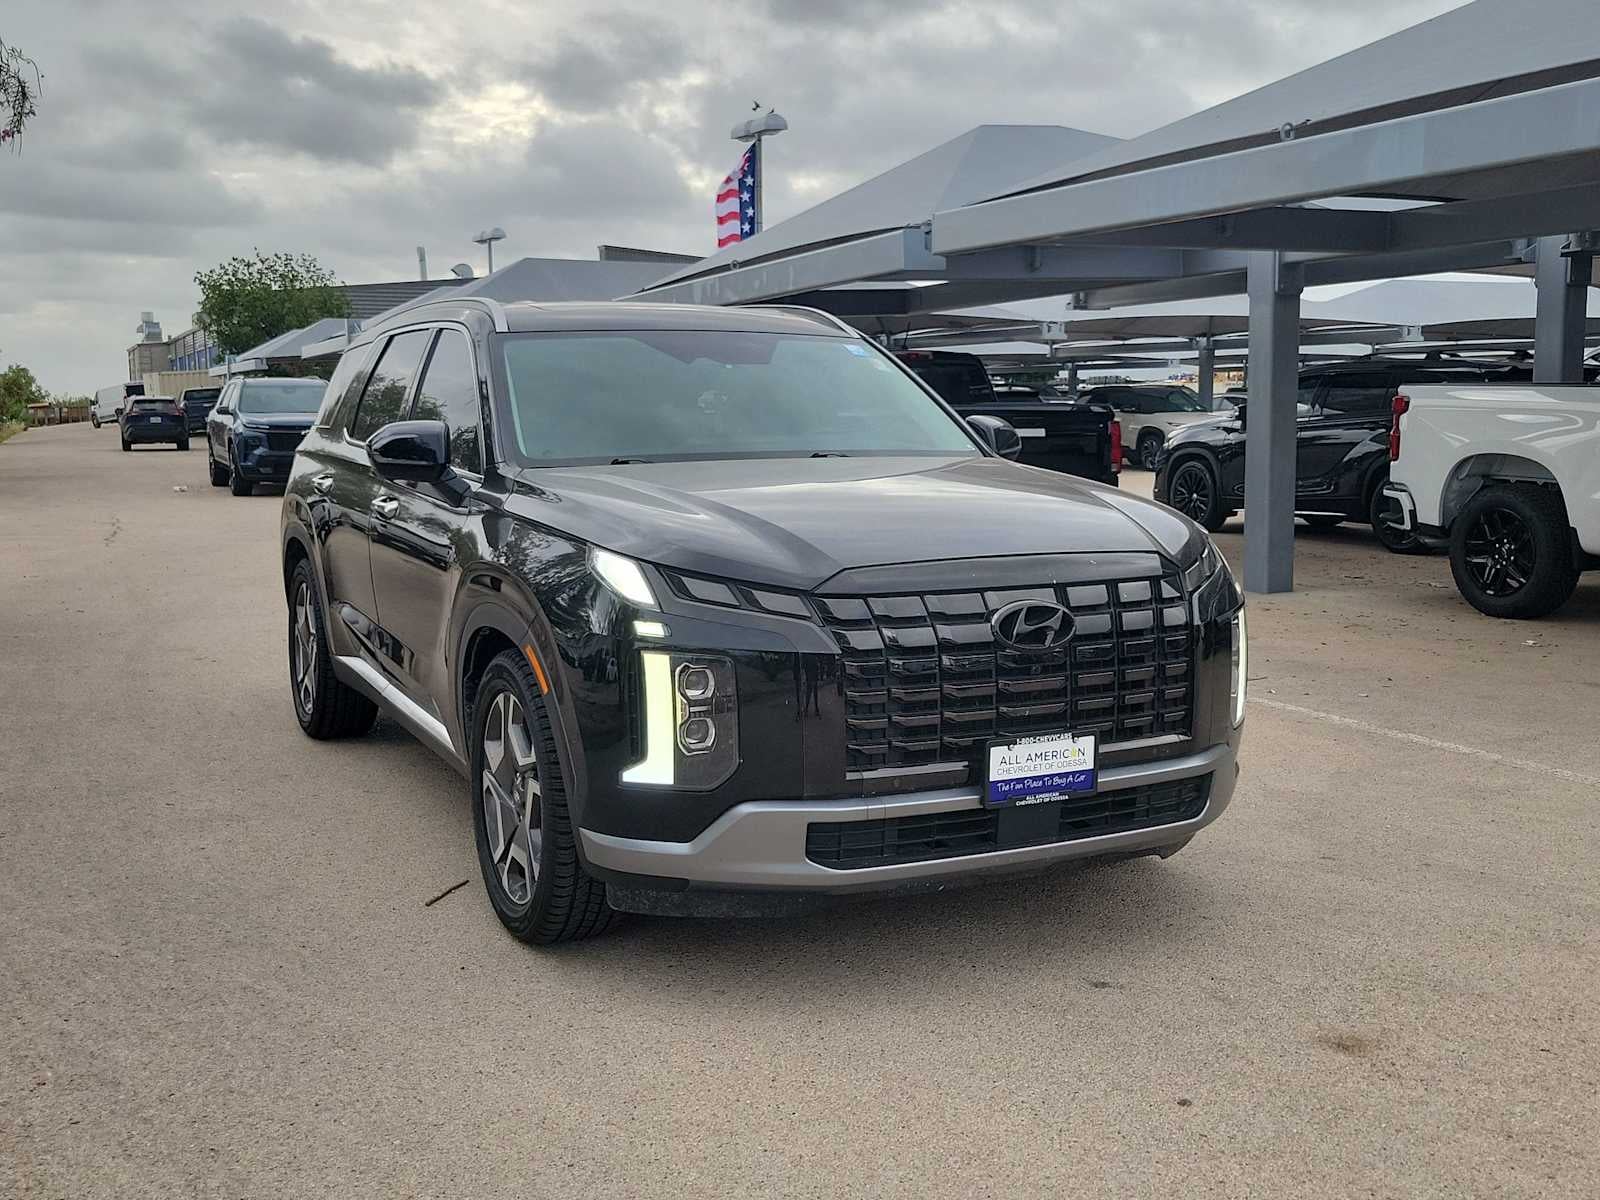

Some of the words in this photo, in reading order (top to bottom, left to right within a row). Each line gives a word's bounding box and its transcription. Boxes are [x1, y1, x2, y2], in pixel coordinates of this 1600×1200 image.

[997, 764, 1042, 775] CHEVROLET
[1057, 758, 1087, 768] ODESSA
[1000, 755, 1021, 765] ALL
[997, 782, 1009, 792] The
[1010, 782, 1023, 790] Fun
[1024, 779, 1042, 789] Place
[1053, 776, 1066, 785] Buy
[1074, 774, 1086, 782] Car
